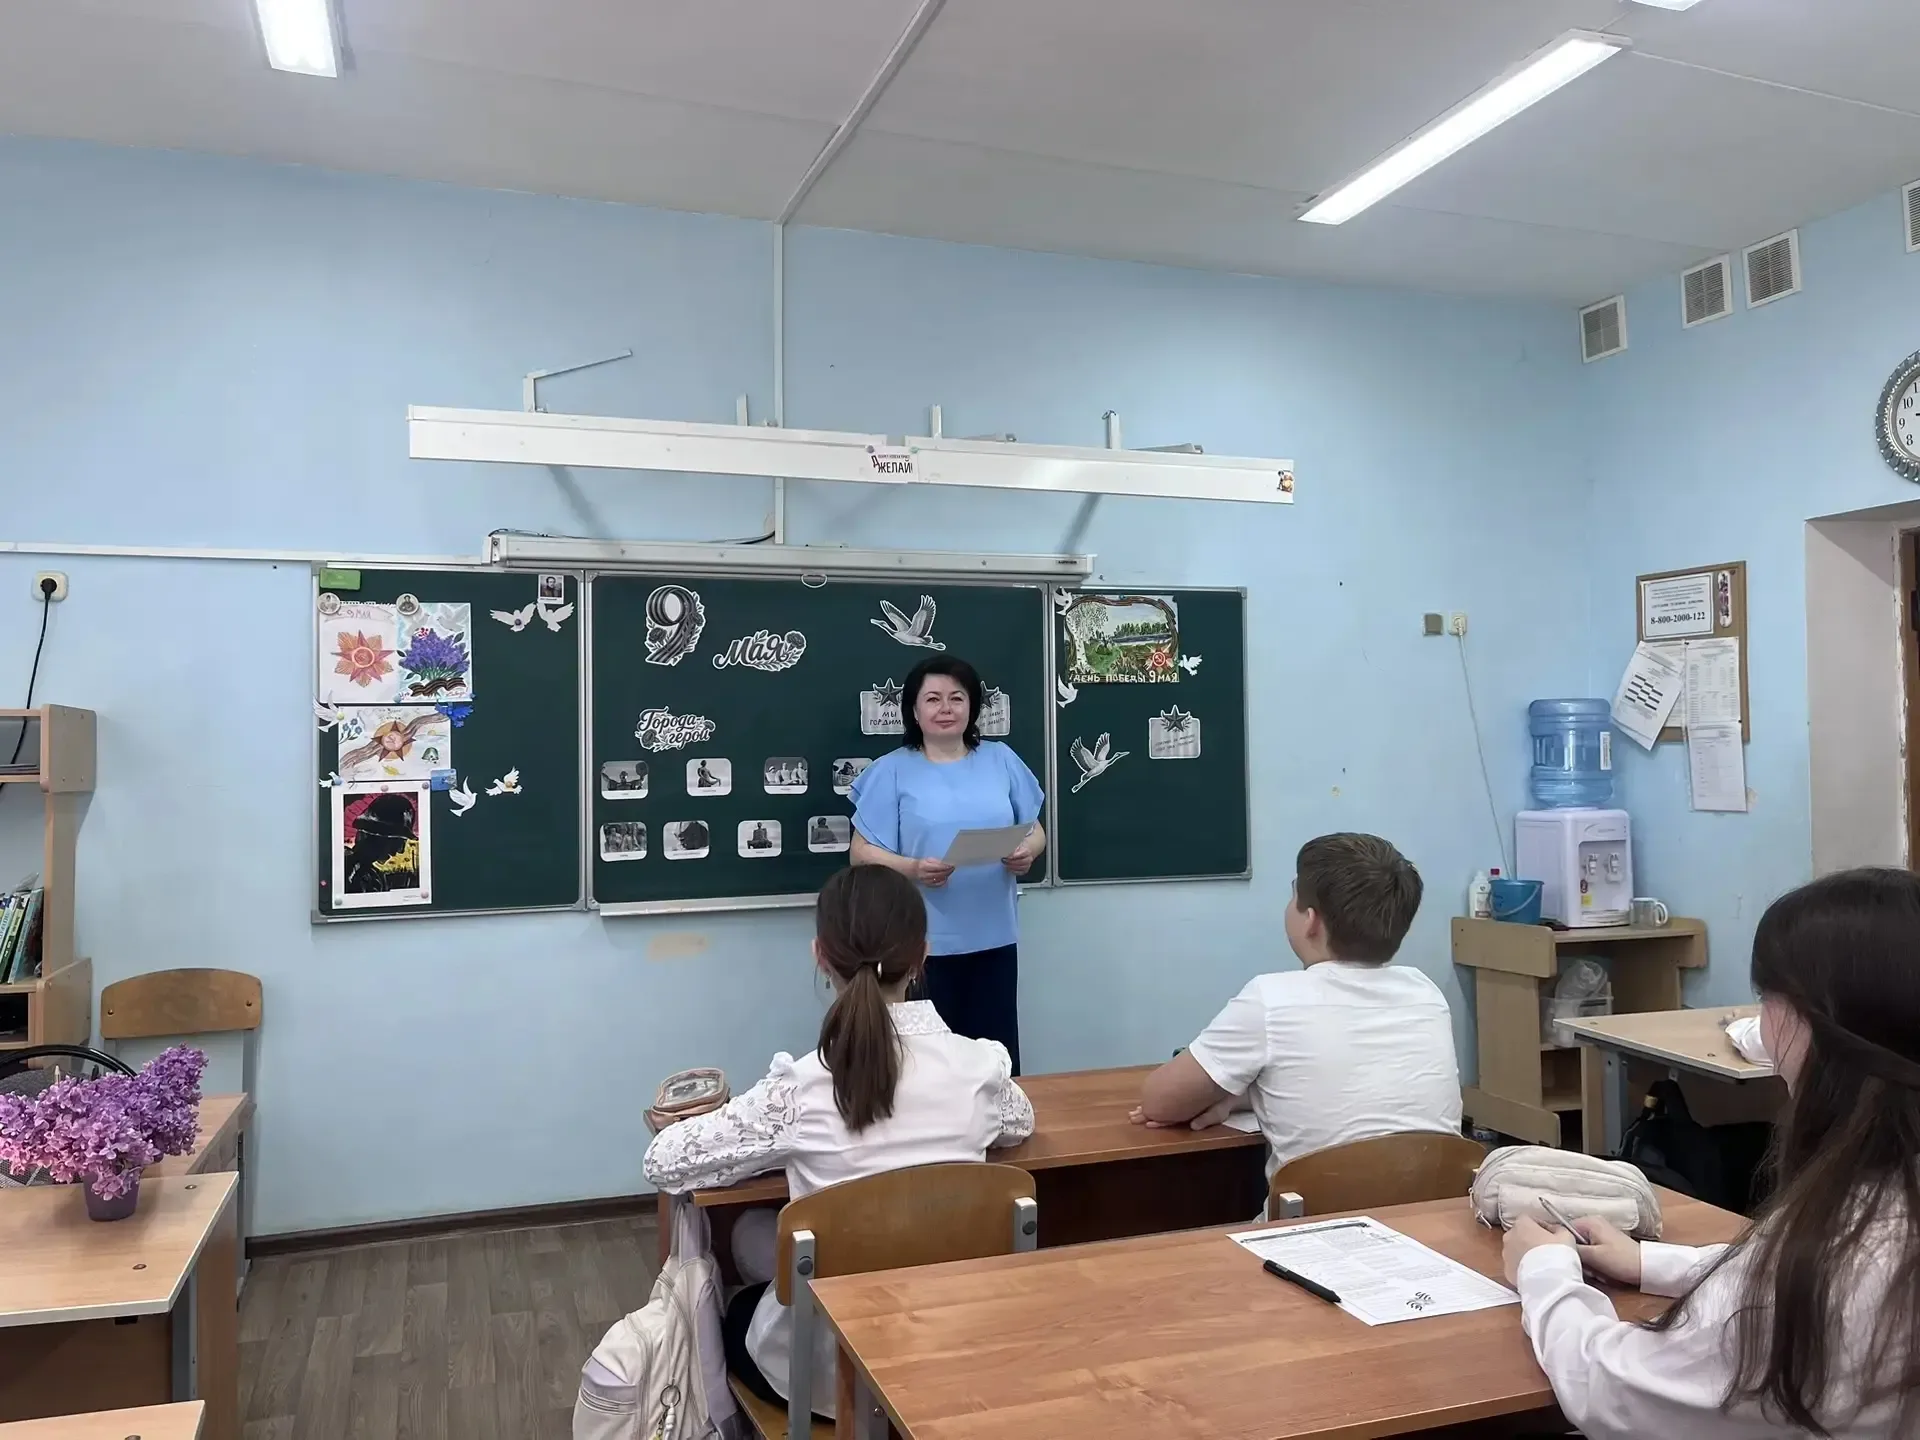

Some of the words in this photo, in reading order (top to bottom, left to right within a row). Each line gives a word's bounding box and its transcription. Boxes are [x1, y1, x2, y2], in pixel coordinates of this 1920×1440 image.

[1903, 396, 1914, 410] 10
[1899, 417, 1906, 430] 9
[1906, 433, 1914, 446] 8
[1650, 611, 1706, 625] 8-800-2000-122
[646, 585, 697, 665] 9
[1073, 673, 1101, 683] ДЕНЬ
[1106, 672, 1145, 683] ПОБЕДЫ
[1149, 670, 1156, 683] 9
[869, 718, 902, 726] ГОРДИМ
